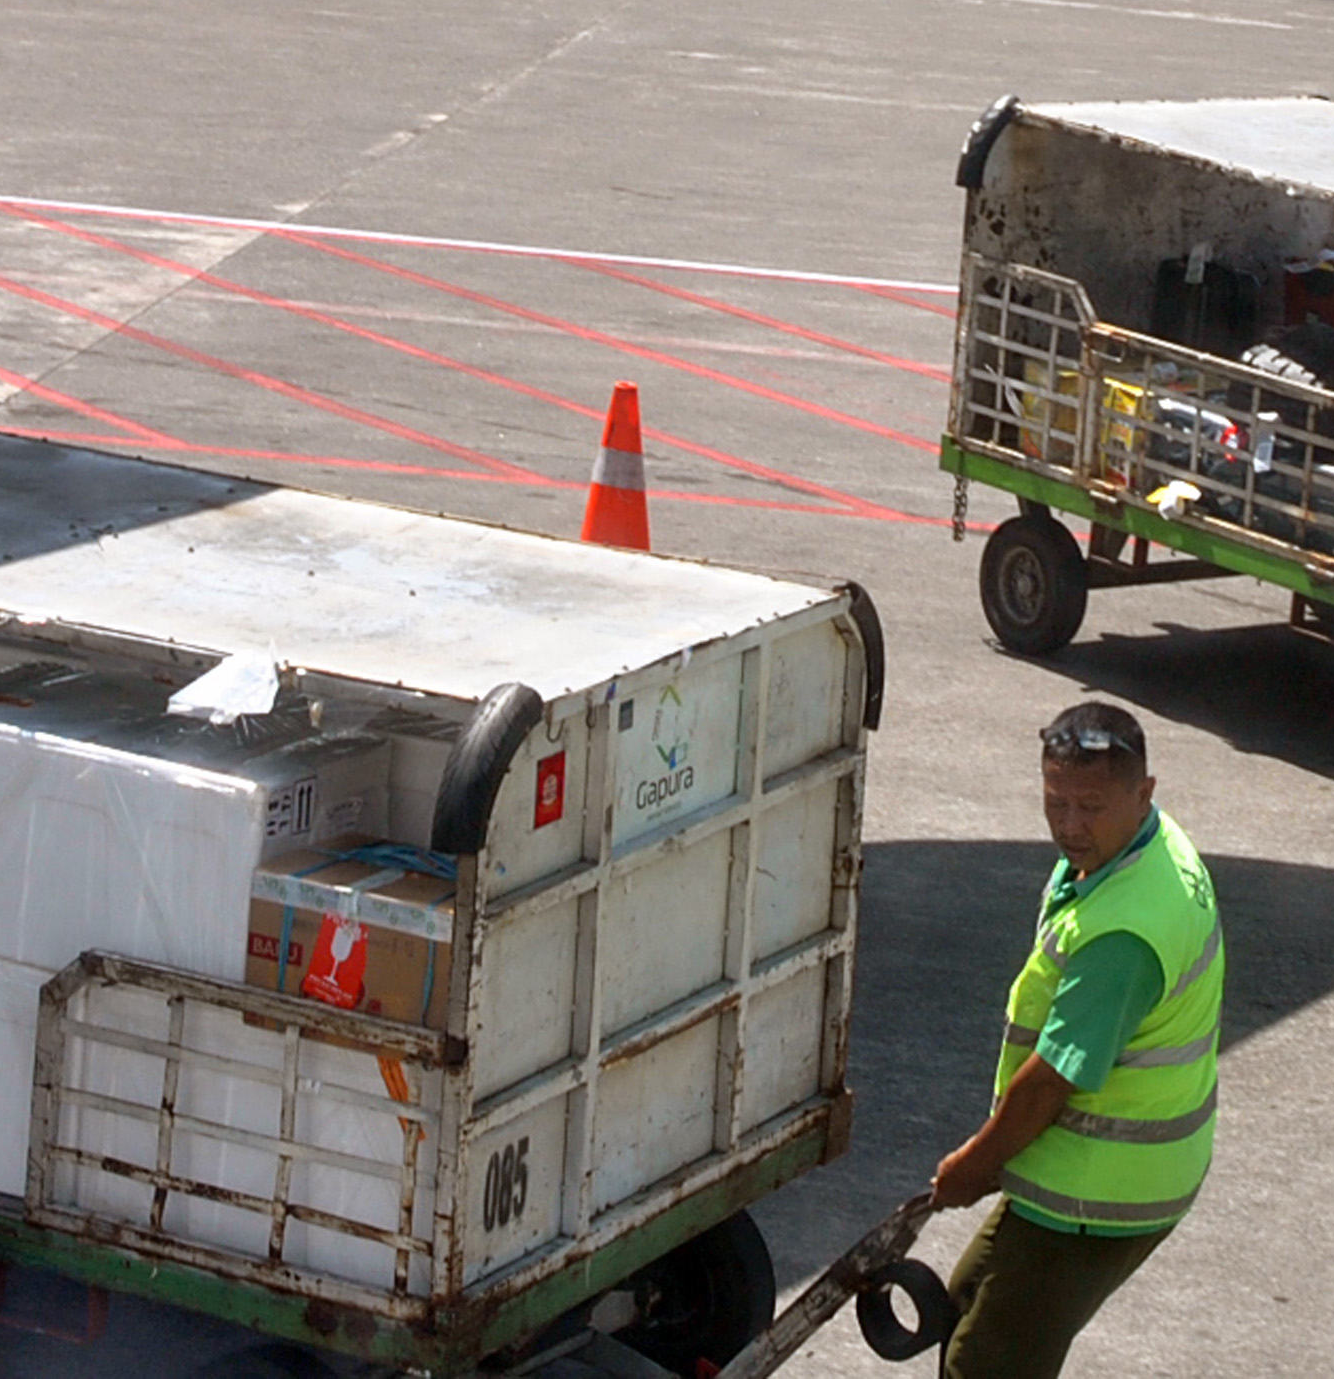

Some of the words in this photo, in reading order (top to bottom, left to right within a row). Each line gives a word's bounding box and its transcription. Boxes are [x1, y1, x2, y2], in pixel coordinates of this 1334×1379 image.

[636, 766, 694, 810] Gapura
[253, 936, 299, 962] BAU
[483, 1135, 529, 1234] 085
